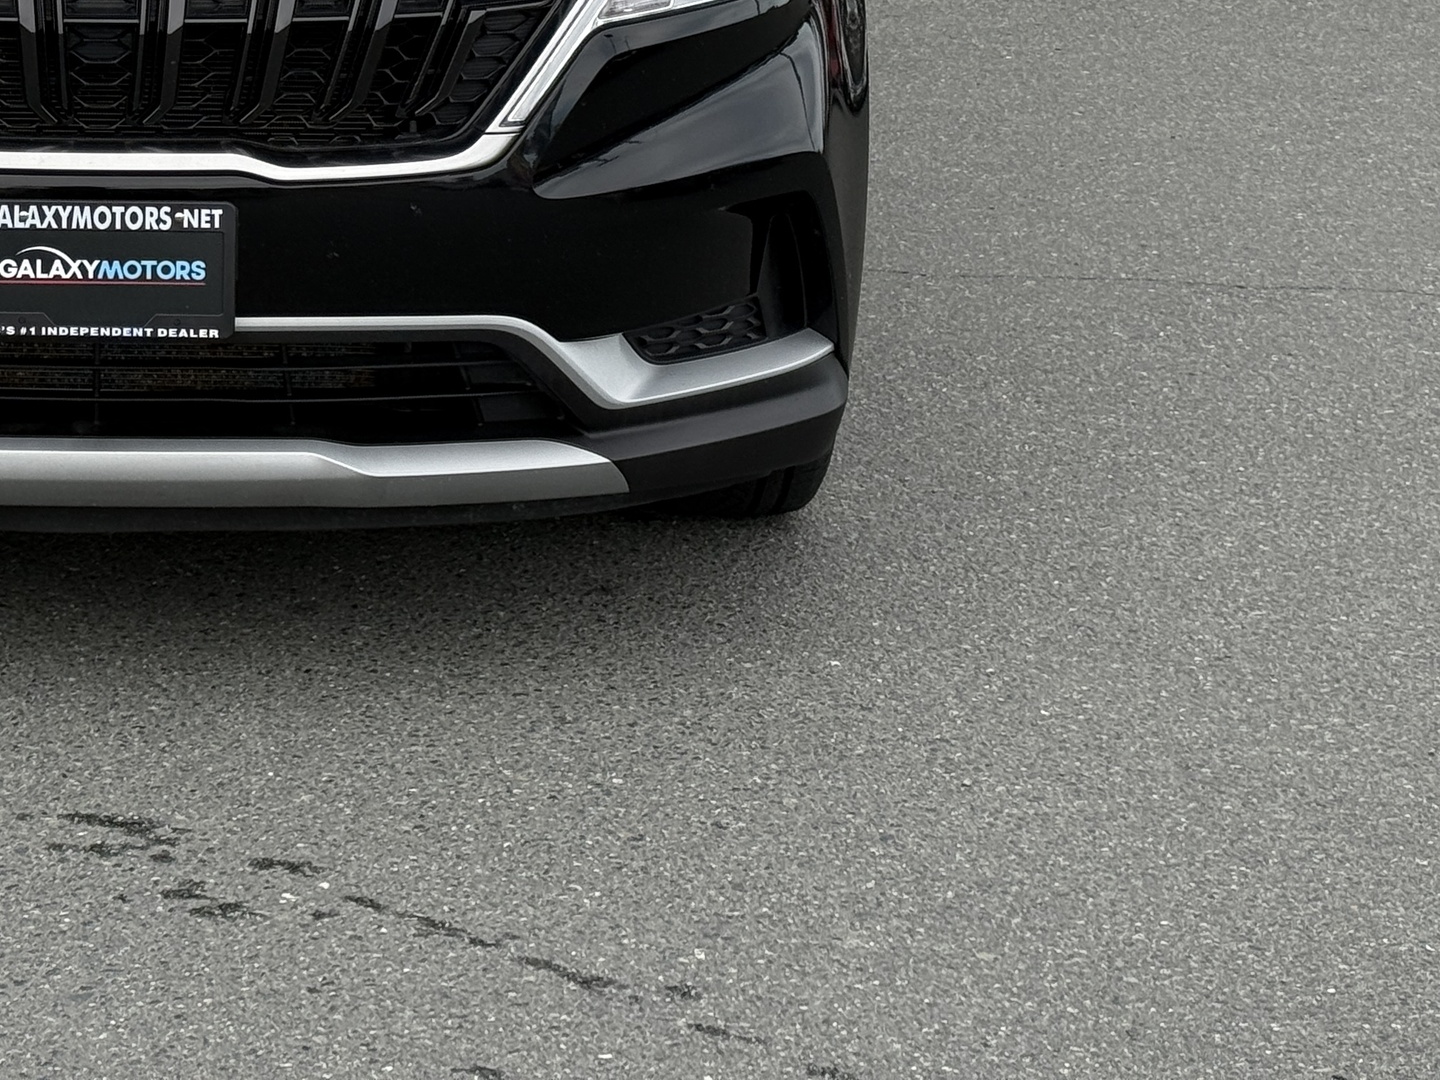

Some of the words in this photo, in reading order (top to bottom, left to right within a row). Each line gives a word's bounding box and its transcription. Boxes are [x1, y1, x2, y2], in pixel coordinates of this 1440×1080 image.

[20, 326, 36, 335] #1
[41, 326, 154, 337] INDEPENDENT
[157, 328, 220, 338] DEALER
